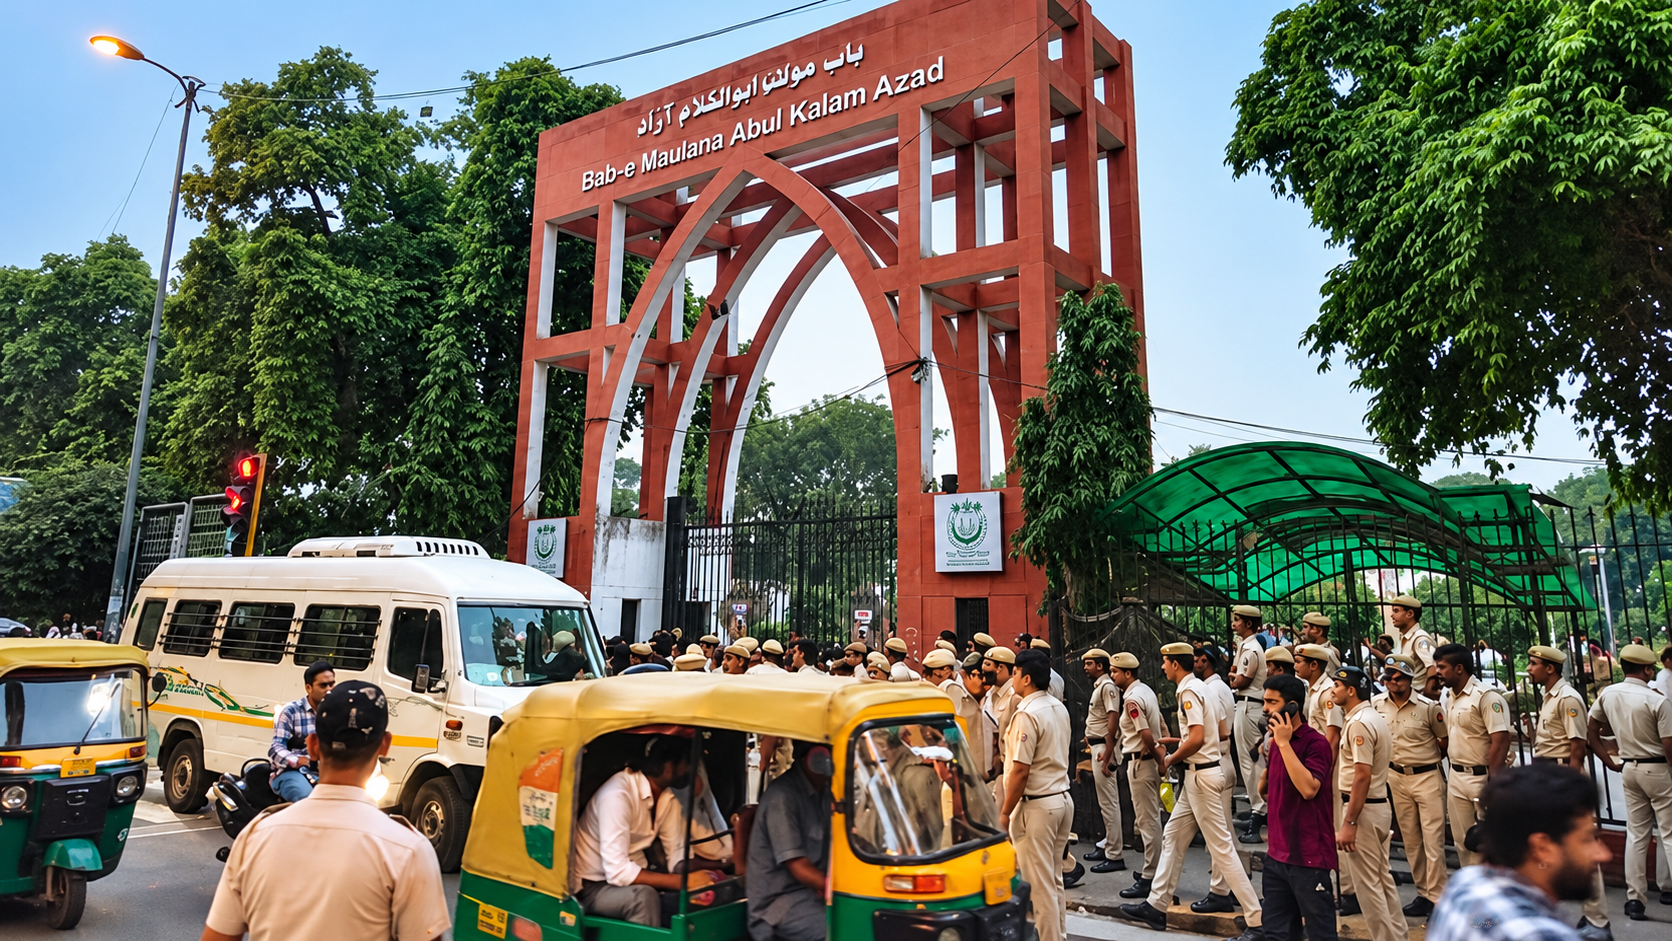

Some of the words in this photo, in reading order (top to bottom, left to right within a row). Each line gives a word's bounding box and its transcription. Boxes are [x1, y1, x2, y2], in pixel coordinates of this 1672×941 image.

[823, 42, 864, 76] باب
[582, 161, 636, 192] Bab-e
[641, 133, 724, 174] Maulana
[730, 108, 782, 147] Abul
[790, 87, 866, 127] Kalam
[873, 56, 944, 101] Azad
